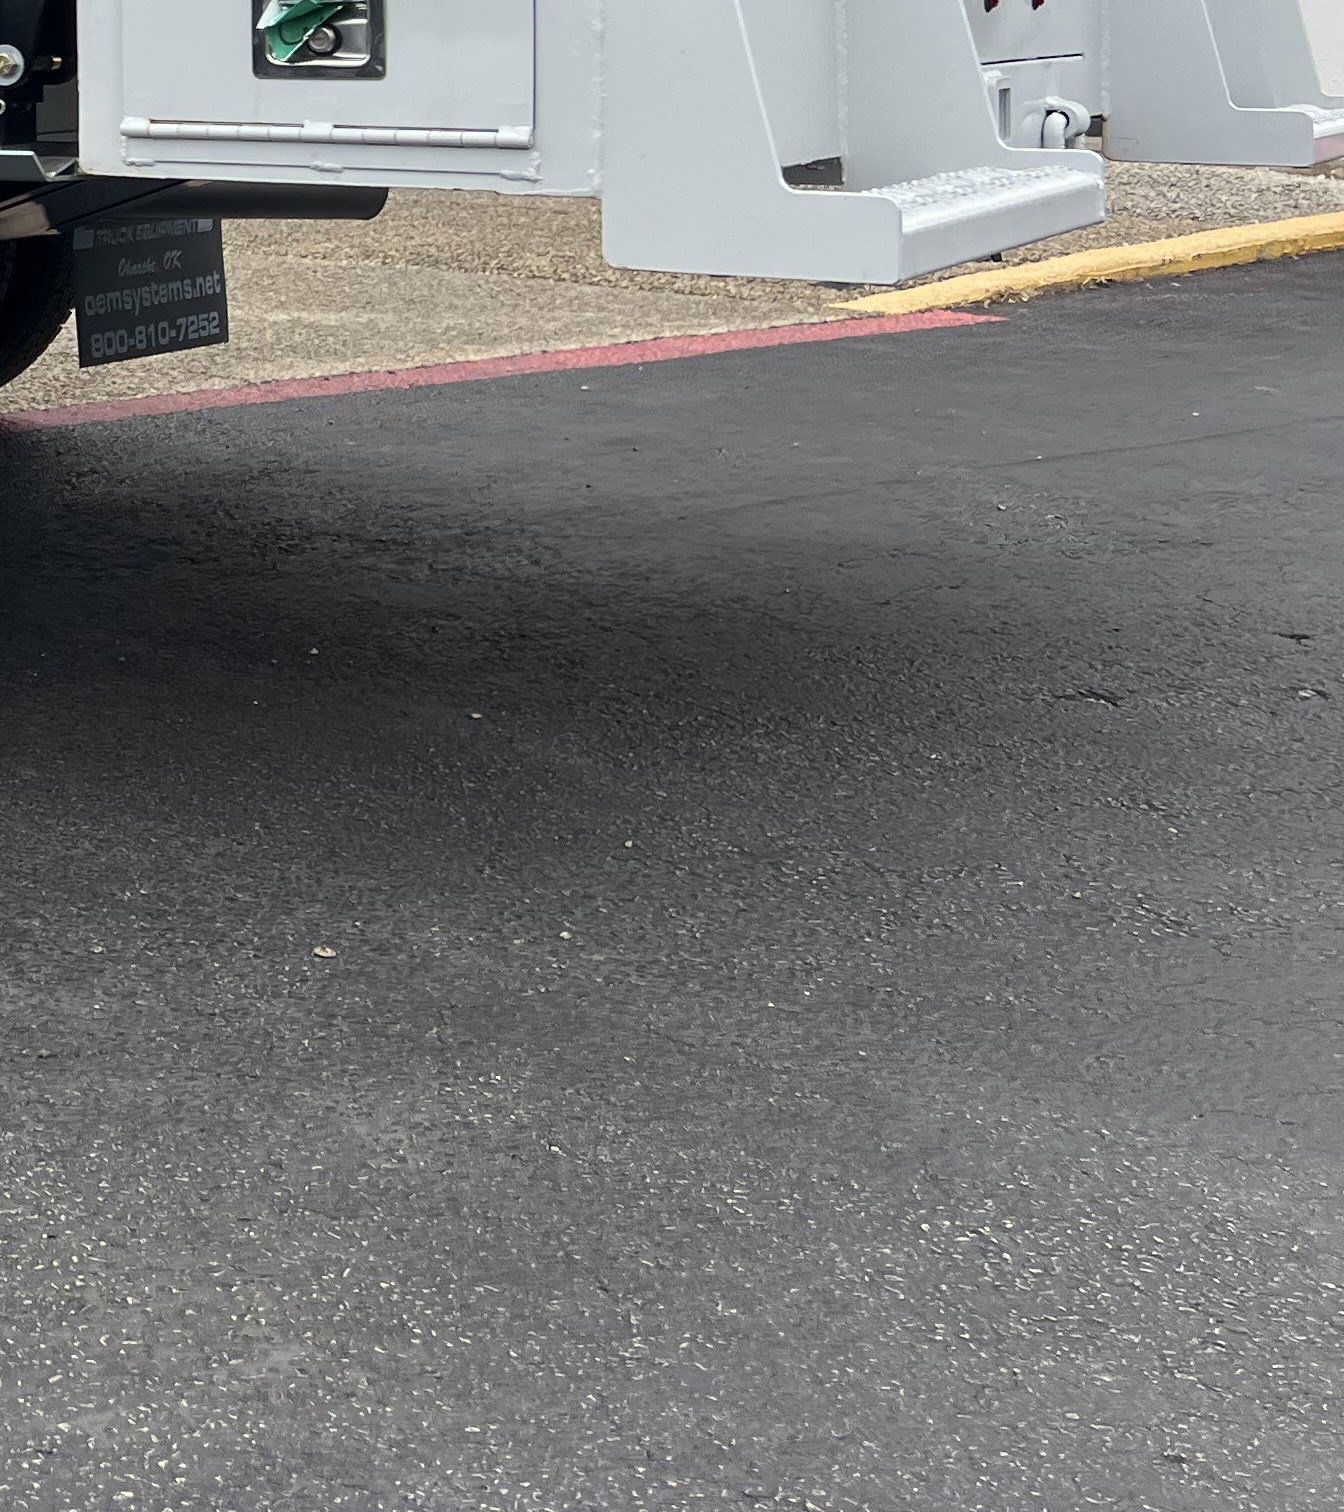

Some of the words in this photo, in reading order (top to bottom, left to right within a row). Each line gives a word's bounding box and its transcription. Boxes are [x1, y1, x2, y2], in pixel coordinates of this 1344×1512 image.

[162, 249, 183, 269] OK
[84, 270, 222, 317] oemsystems.net
[90, 311, 221, 359] 800-810-7252
